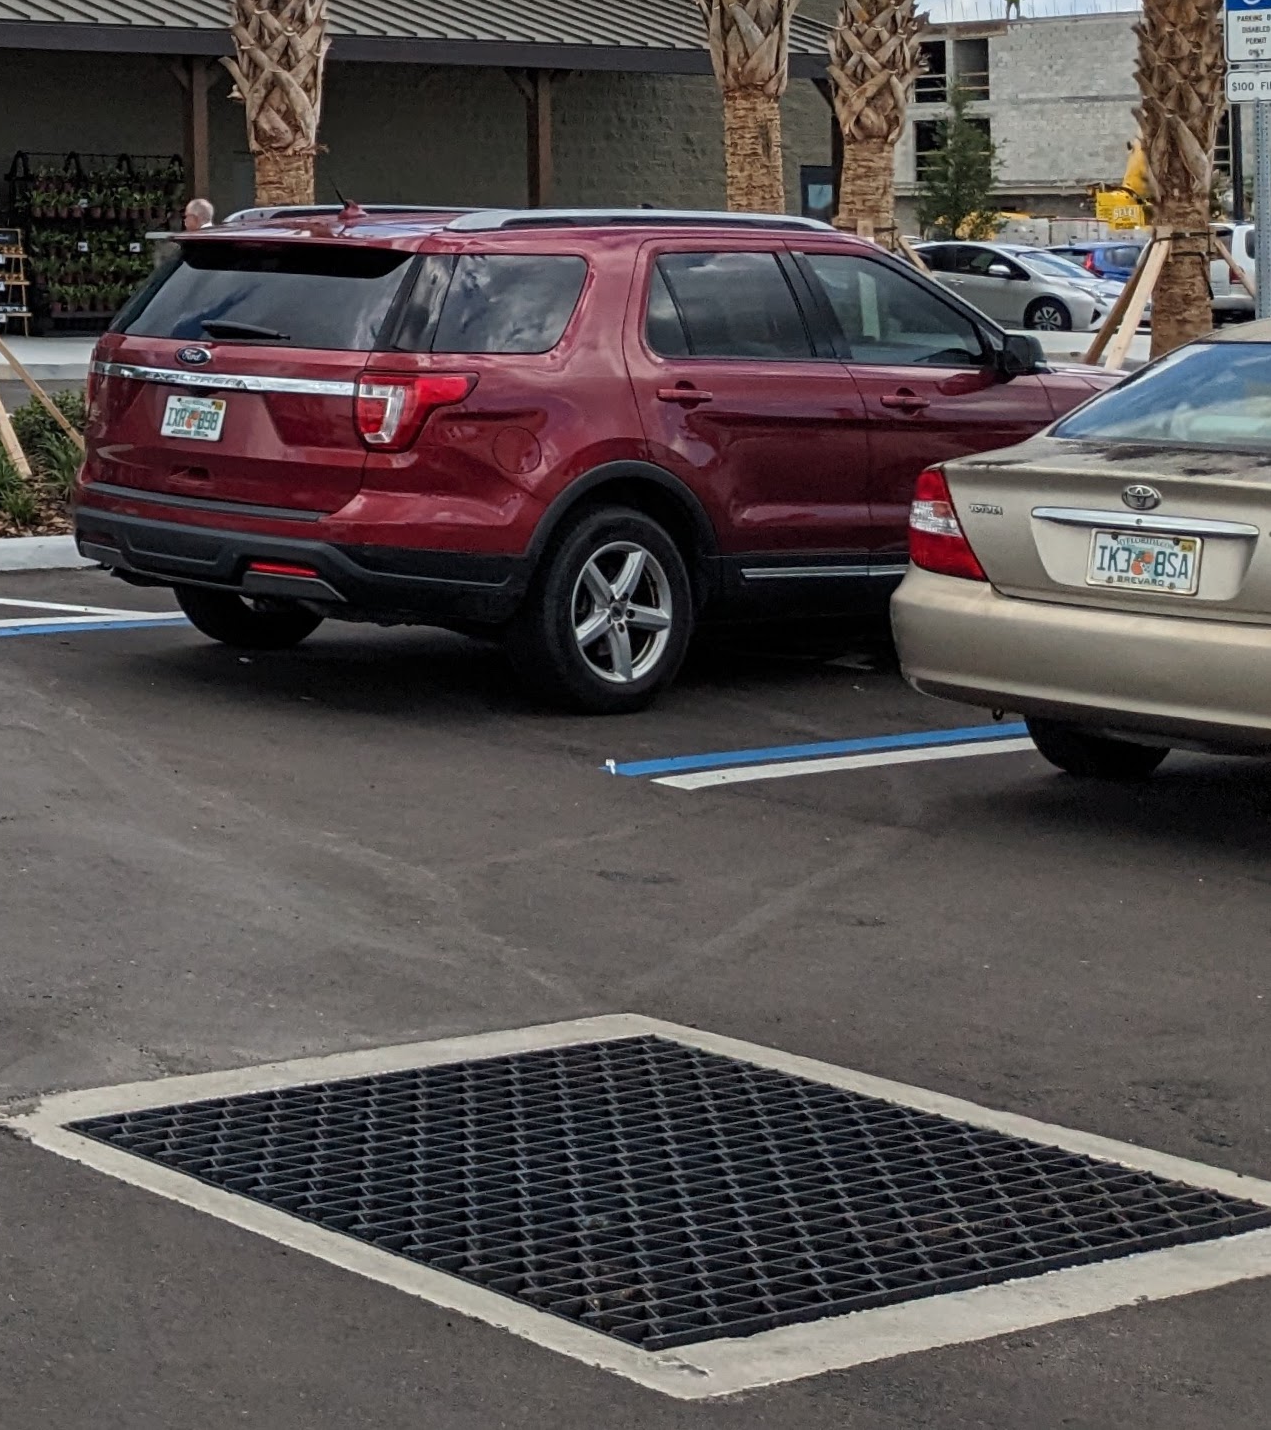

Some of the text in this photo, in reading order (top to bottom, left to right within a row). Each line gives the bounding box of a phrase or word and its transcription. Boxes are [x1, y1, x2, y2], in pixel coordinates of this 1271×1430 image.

[1237, 14, 1263, 22] PARKING
[1241, 26, 1270, 34] DISABLED
[1245, 36, 1267, 44] PERMIT
[1232, 81, 1255, 92] $100
[181, 350, 201, 361] Ford
[1116, 574, 1165, 587] BREVARD
